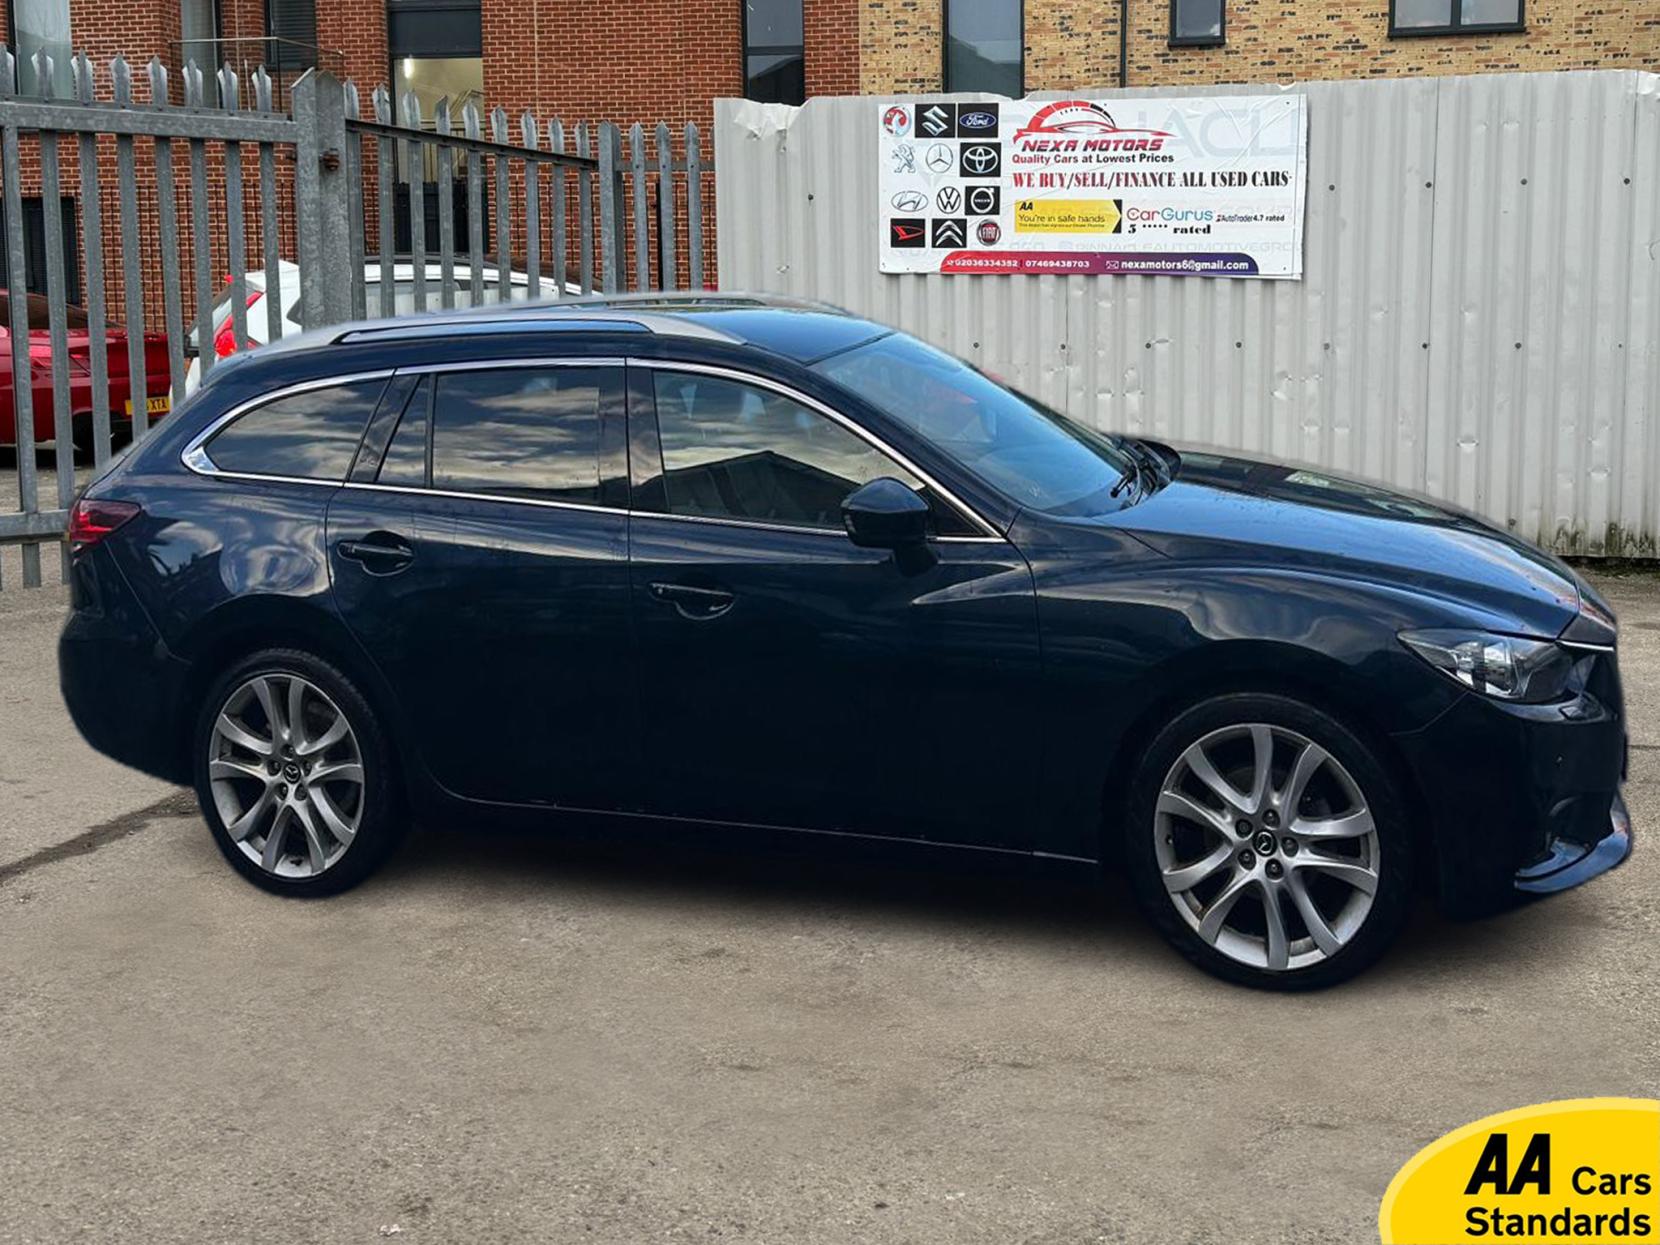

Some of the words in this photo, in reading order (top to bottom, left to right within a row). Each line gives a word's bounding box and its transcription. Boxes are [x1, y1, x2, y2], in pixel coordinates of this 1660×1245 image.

[1022, 139, 1079, 152] NEXA
[1083, 138, 1164, 152] MOTORS
[1012, 154, 1051, 165] Quality
[1054, 154, 1079, 164] Cars
[1082, 154, 1093, 163] at
[1096, 154, 1136, 163] Lowest
[1139, 153, 1174, 163] Prices
[1012, 172, 1035, 188] WE
[1180, 171, 1207, 187] ALL
[1211, 171, 1248, 187] USED
[1019, 201, 1034, 211] AA
[1018, 214, 1046, 223] You're
[1048, 214, 1056, 223] in
[1057, 214, 1075, 223] safe
[1079, 214, 1106, 223] hands
[1126, 207, 1214, 222] CarGurus
[1266, 214, 1285, 222] rated
[1127, 224, 1137, 234] 5
[1173, 224, 1211, 234] rated
